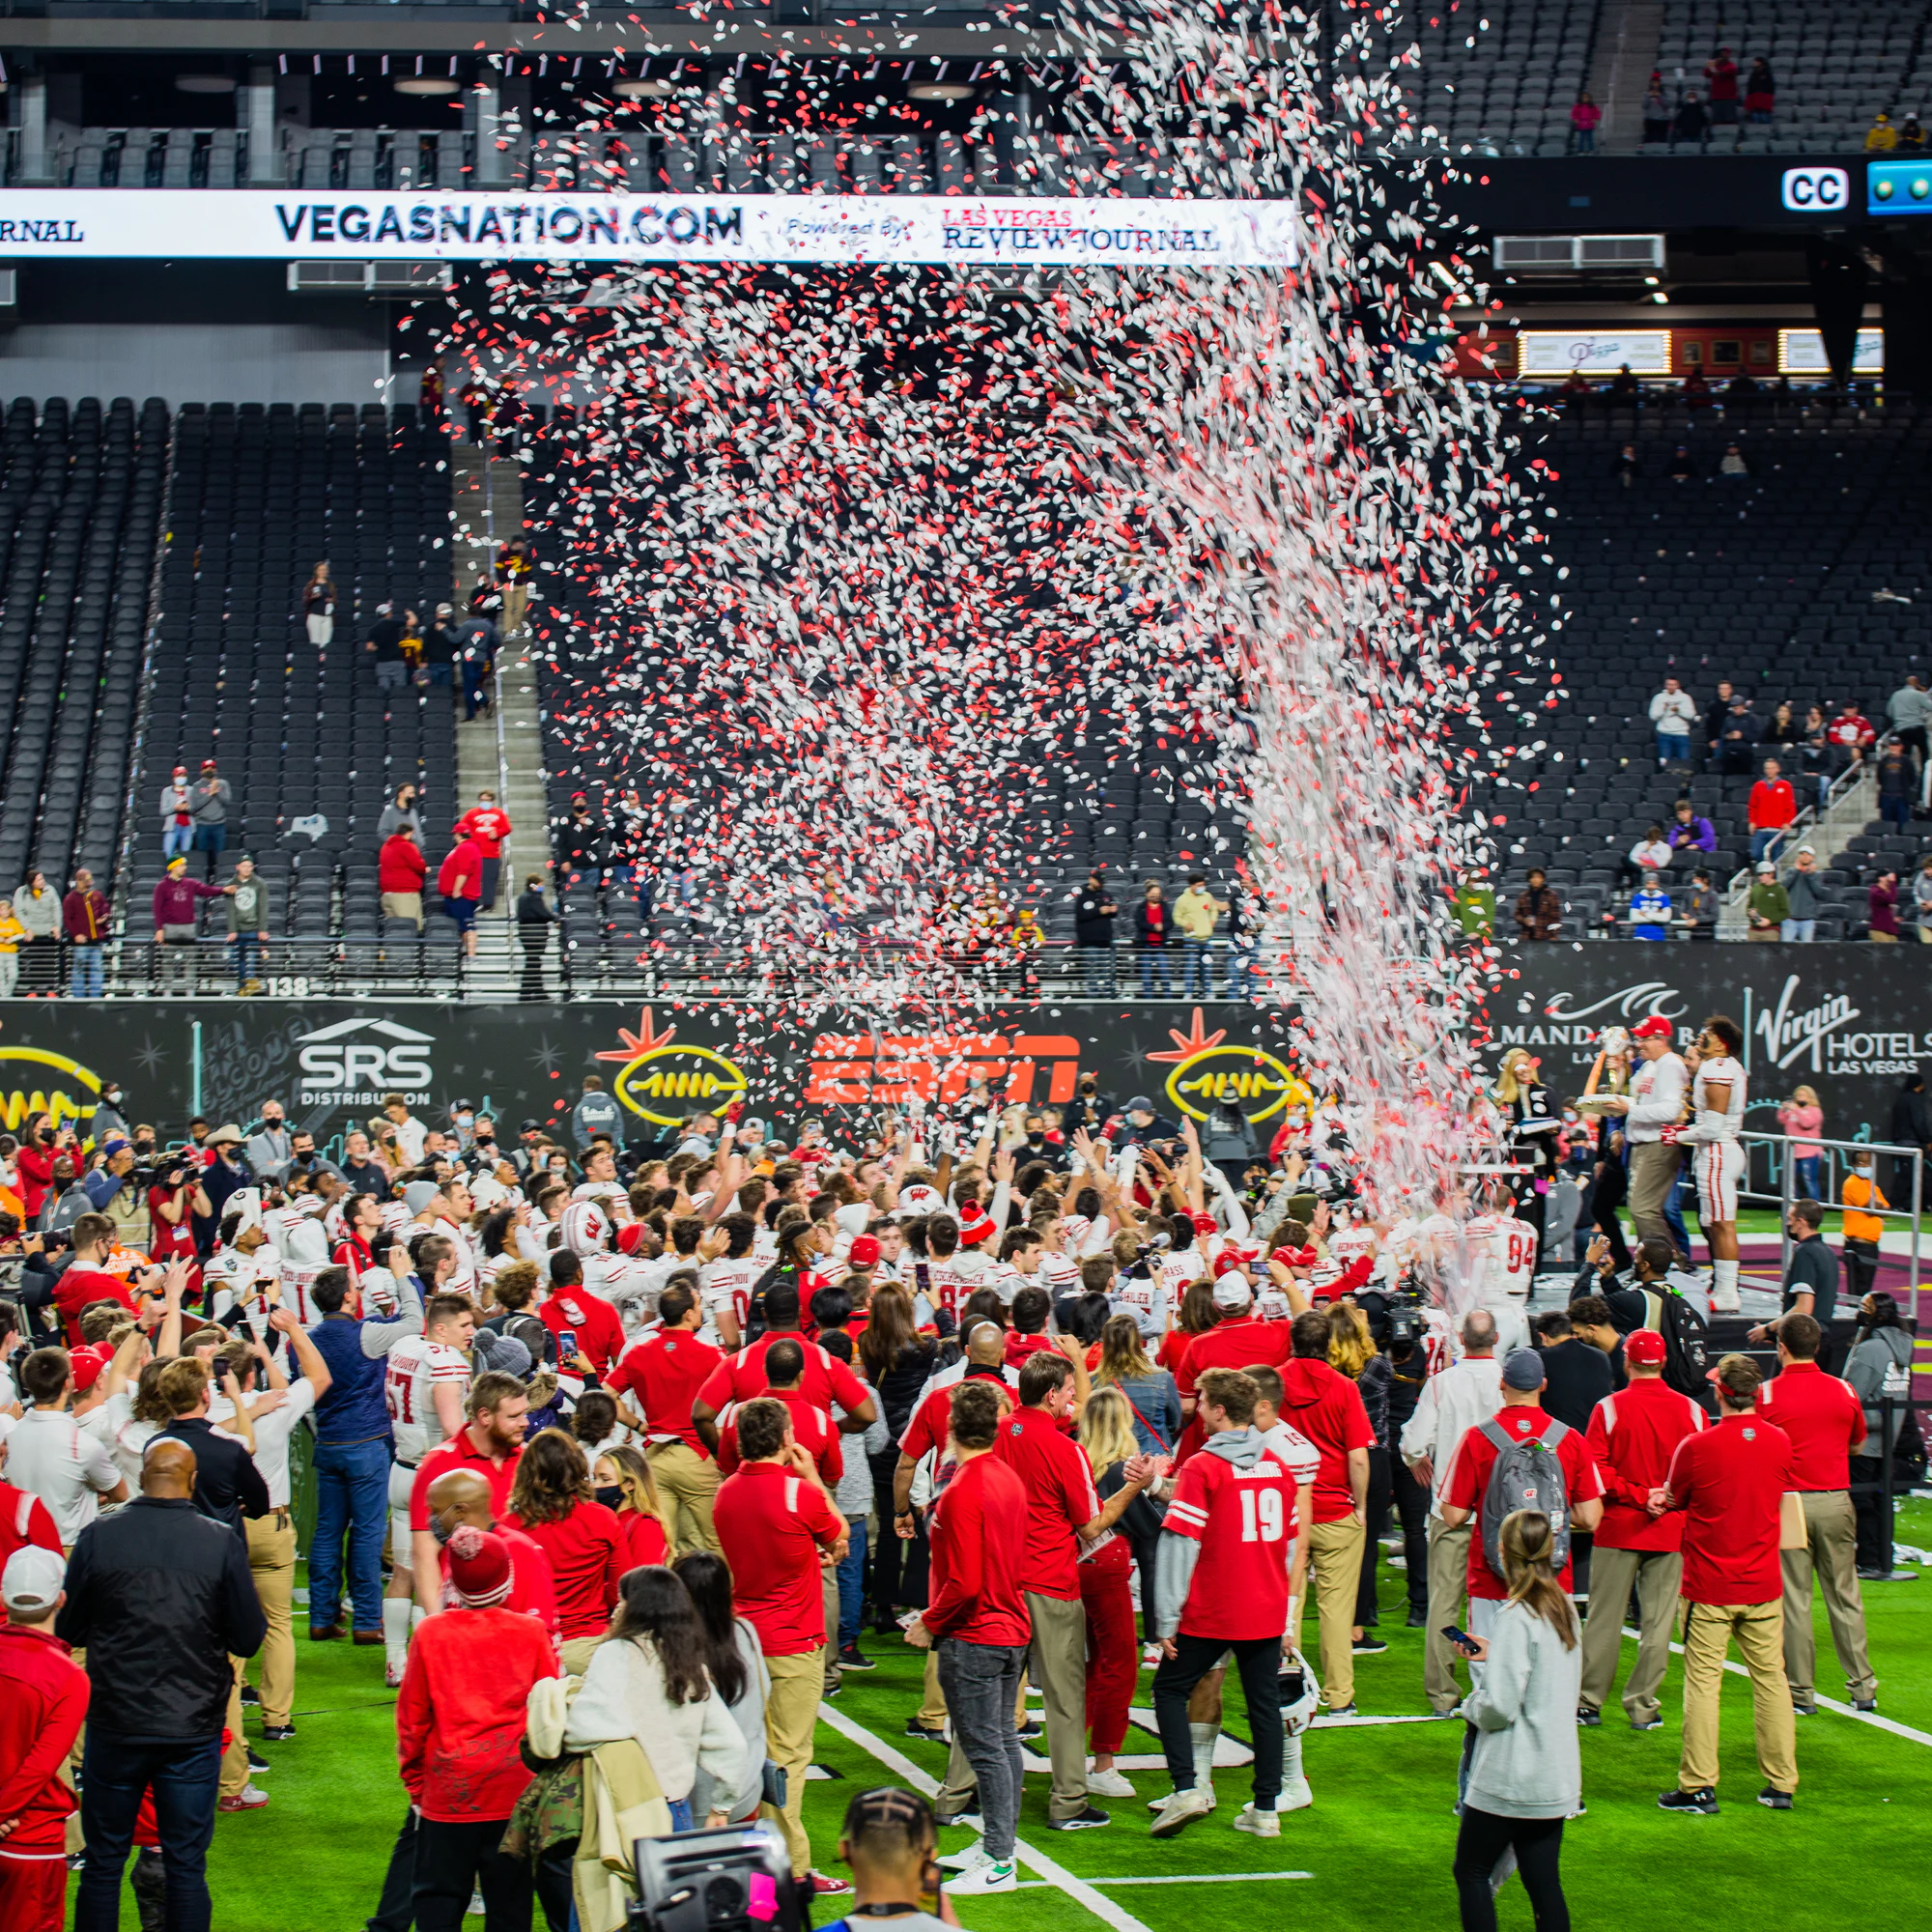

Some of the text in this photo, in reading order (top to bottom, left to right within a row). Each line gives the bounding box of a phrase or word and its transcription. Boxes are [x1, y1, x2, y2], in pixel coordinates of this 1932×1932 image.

[1792, 174, 1840, 205] CC
[274, 204, 743, 245] VEGASNATION.COM
[942, 209, 1072, 228] LAS VEGAS
[942, 227, 1220, 252] REVIEW-JOURNAL
[267, 977, 309, 997] 138
[1754, 974, 1861, 1073] Virgin
[298, 1045, 433, 1089] SRS
[808, 1035, 1081, 1103] ESPN
[1827, 1060, 1919, 1075] LAS VEGAS
[301, 1093, 431, 1106] DISTRIBUON
[1239, 1488, 1284, 1543] 19
